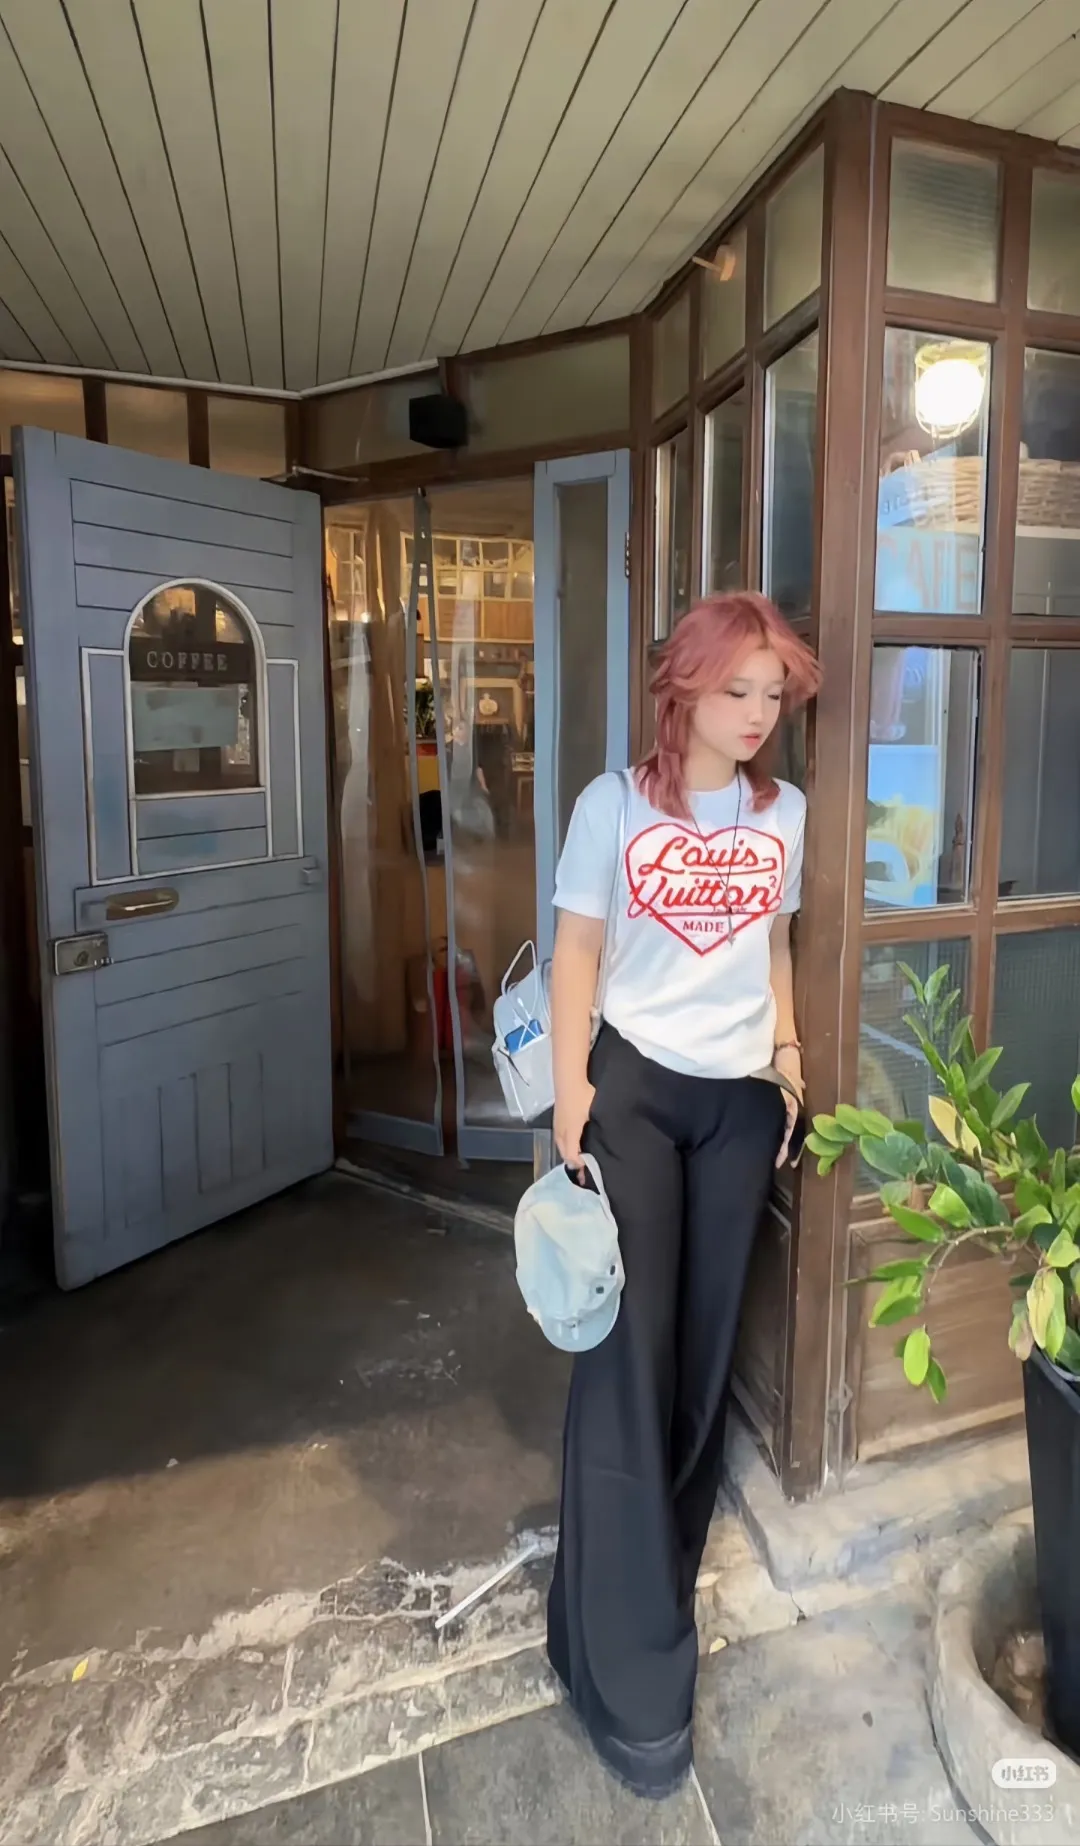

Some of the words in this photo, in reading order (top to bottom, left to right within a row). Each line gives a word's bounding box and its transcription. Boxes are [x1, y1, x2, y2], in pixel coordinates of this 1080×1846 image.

[146, 651, 228, 671] COFFEE
[638, 836, 777, 876] Louis
[628, 876, 782, 918] Vuitton
[682, 920, 725, 934] MADE
